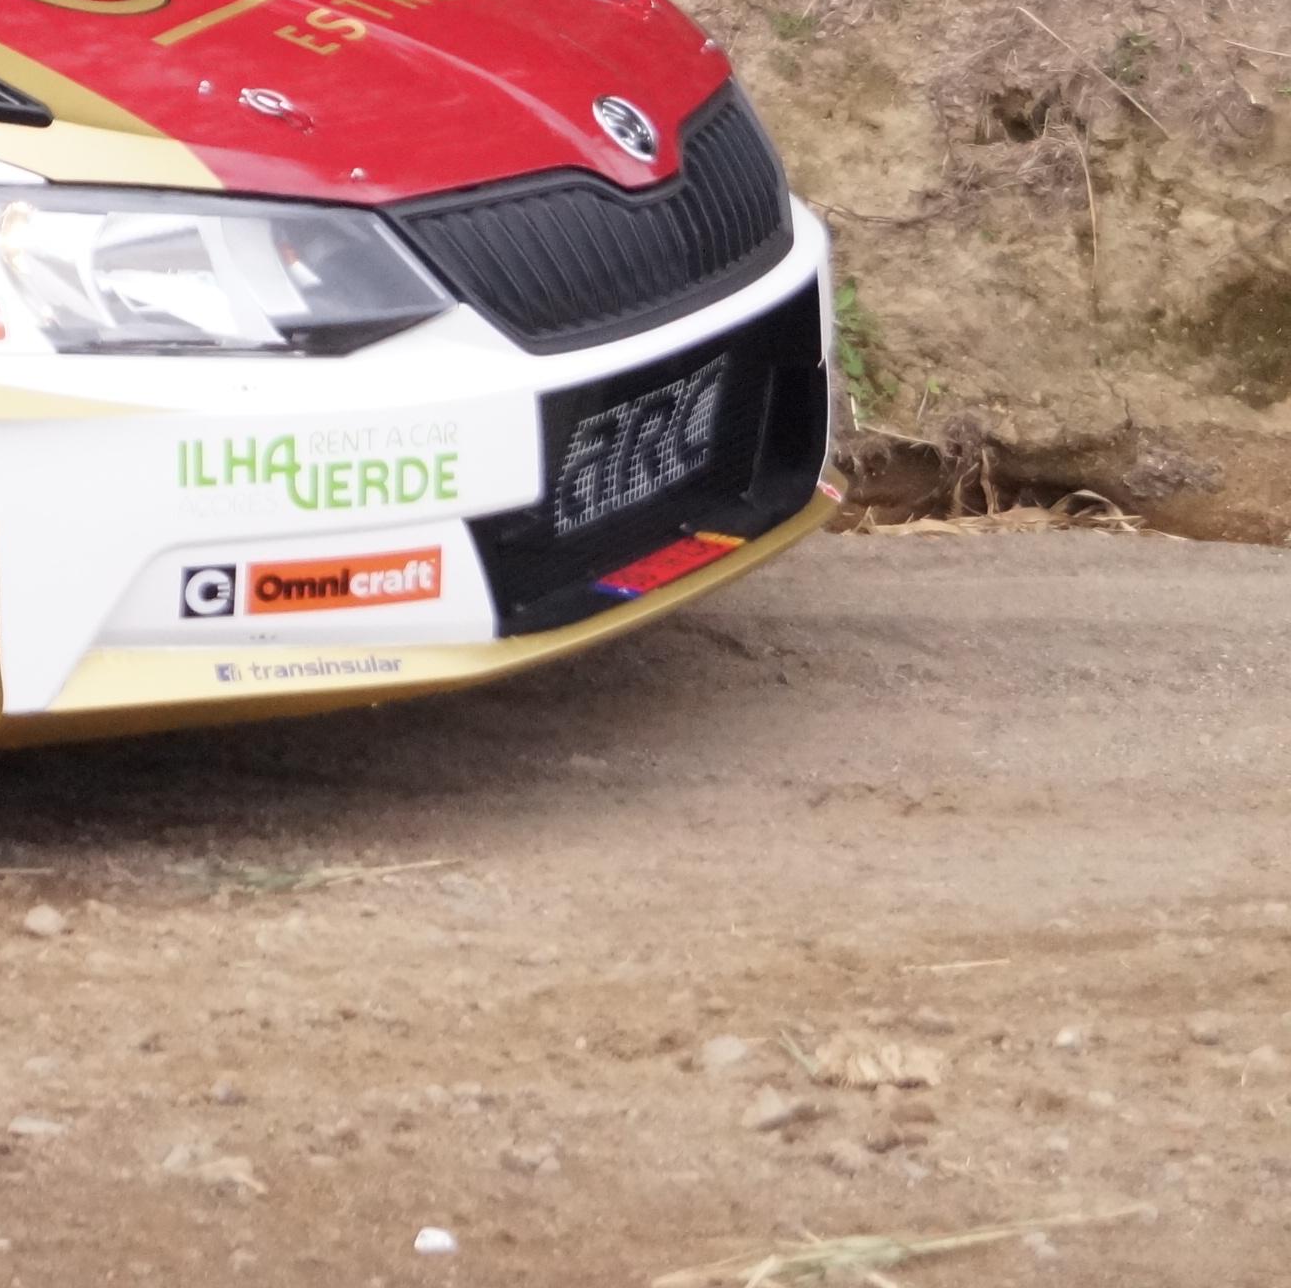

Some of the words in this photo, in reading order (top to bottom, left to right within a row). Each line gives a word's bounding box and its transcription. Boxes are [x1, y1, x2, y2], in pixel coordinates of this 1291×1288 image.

[309, 426, 378, 456] RENT
[385, 425, 404, 449] A
[408, 421, 459, 448] CAR
[177, 433, 297, 489] ILHA
[255, 558, 433, 602] Omnicraft
[251, 656, 402, 681] transinsular
